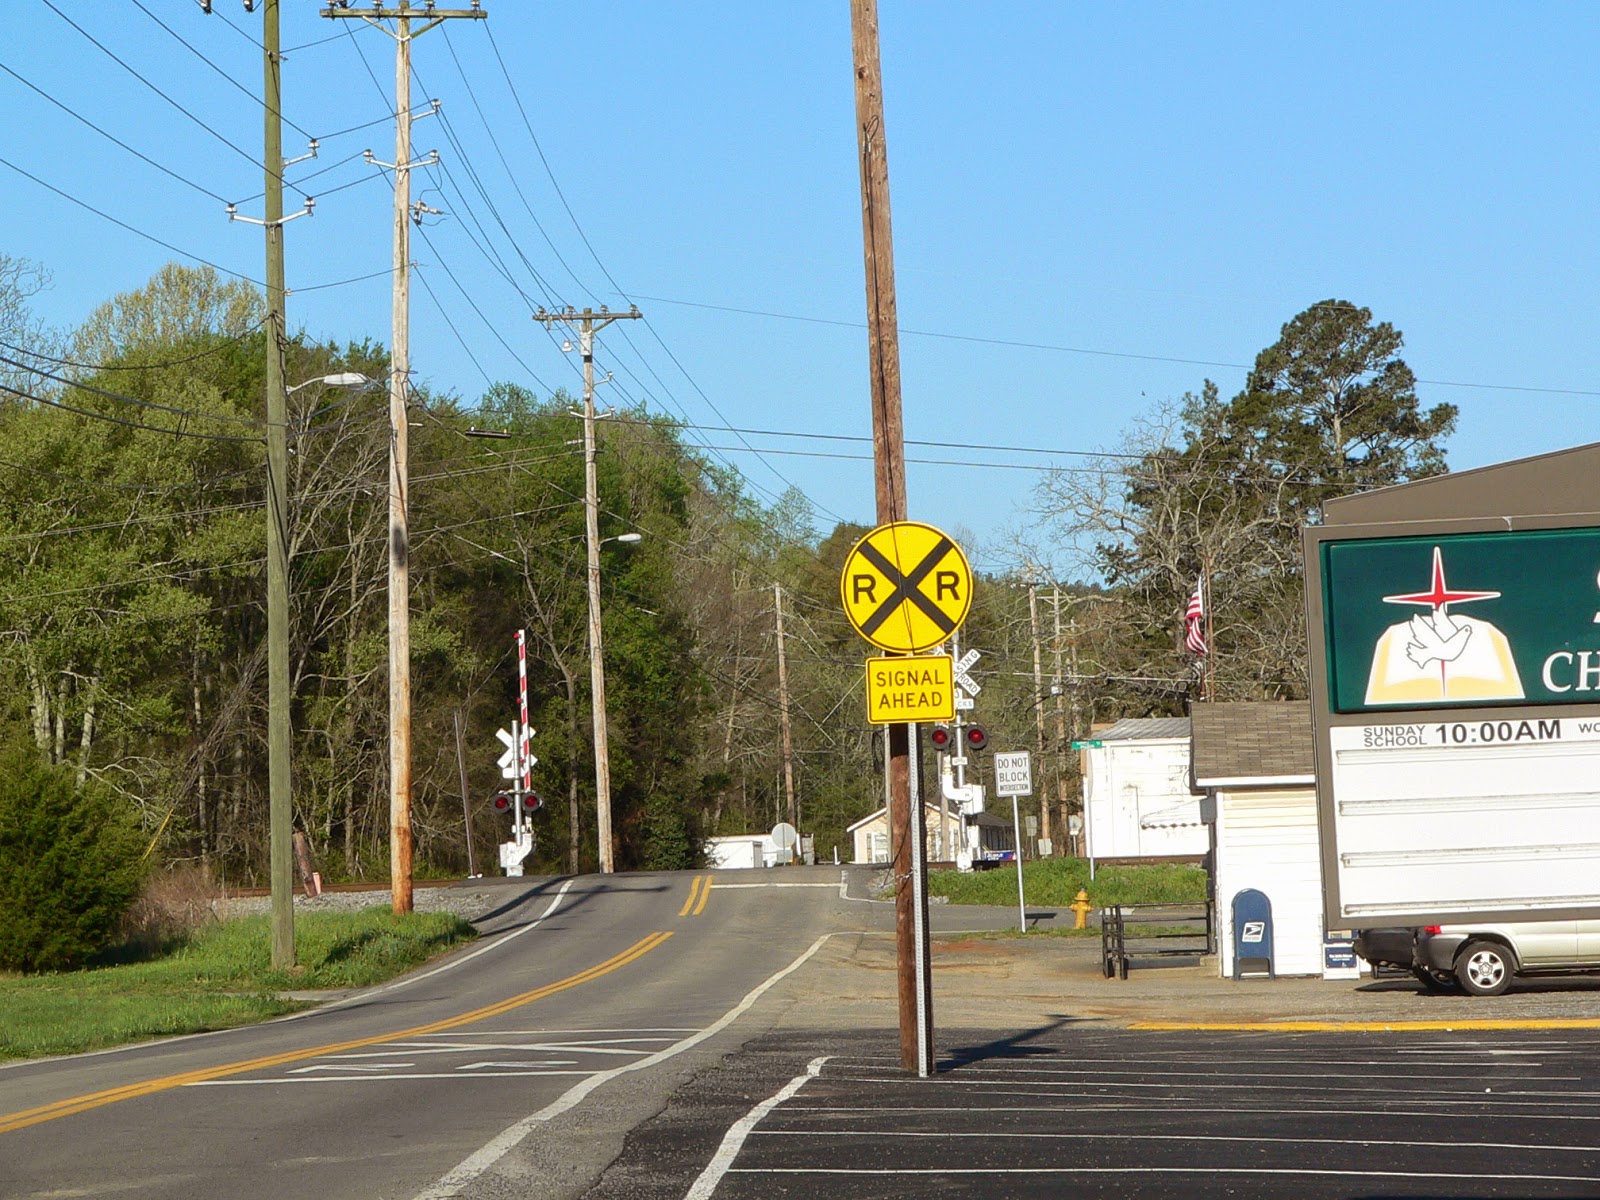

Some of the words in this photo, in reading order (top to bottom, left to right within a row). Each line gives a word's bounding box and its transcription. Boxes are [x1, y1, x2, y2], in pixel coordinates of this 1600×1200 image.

[853, 574, 877, 604] R
[936, 571, 960, 601] R
[876, 669, 945, 688] SIGNAL
[878, 691, 943, 709] AHEAD
[1363, 725, 1426, 737] SUNDAY
[1435, 720, 1562, 744] 10:00AM
[1363, 735, 1428, 747] SCHOOL
[998, 758, 1009, 769] DO
[1012, 757, 1028, 768] NOT
[999, 771, 1028, 782] BLOCK
